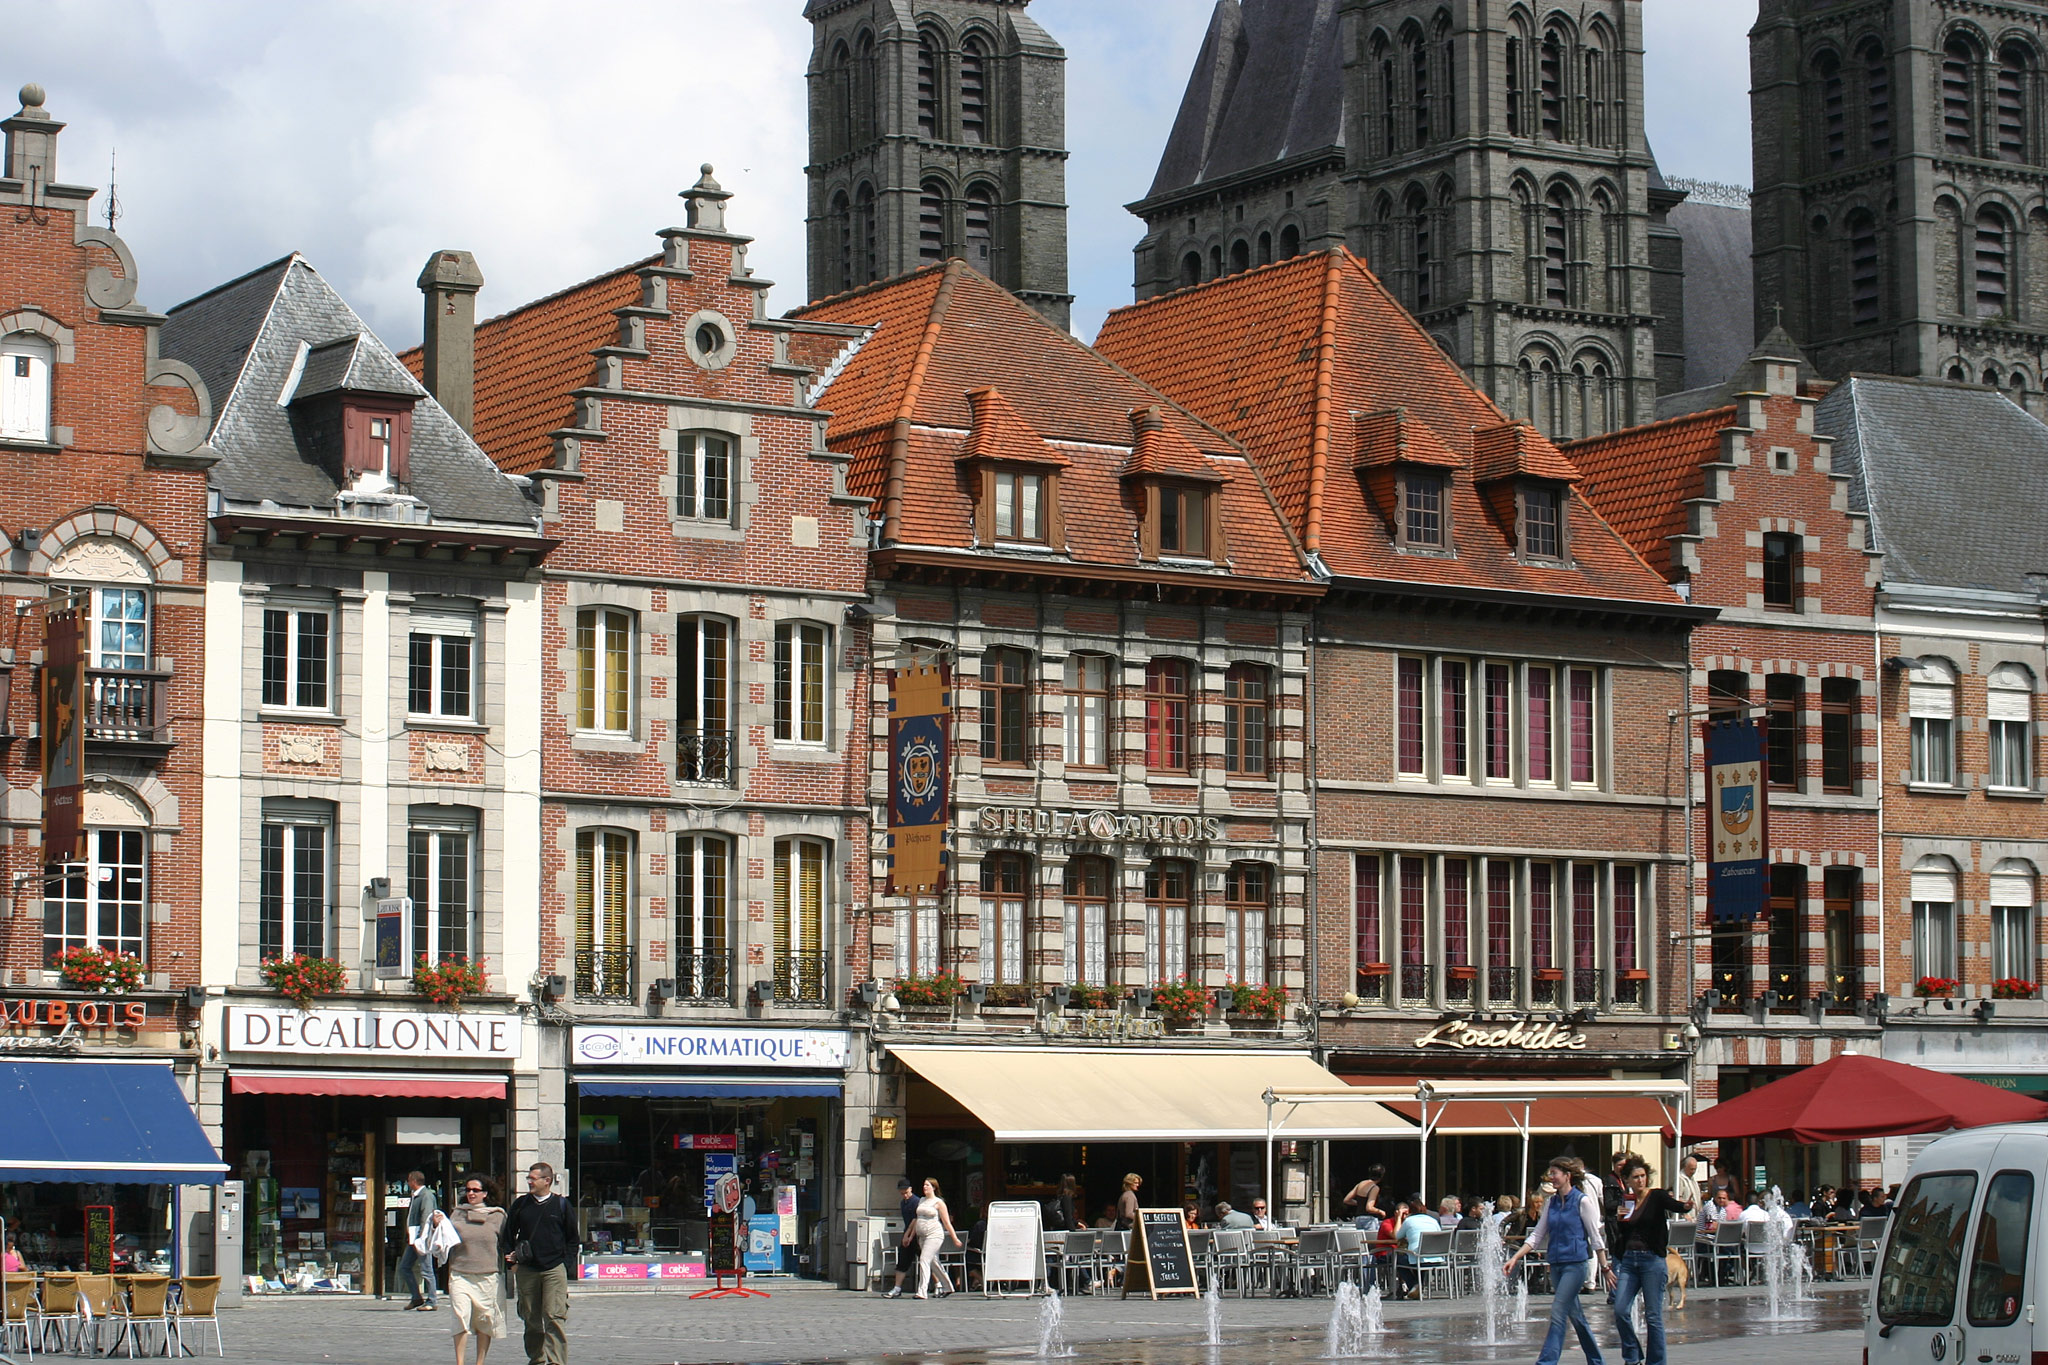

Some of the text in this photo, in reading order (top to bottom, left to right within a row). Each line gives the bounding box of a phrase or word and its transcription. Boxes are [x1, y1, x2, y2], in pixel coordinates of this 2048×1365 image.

[978, 805, 1219, 841] STELLA ARTOIS
[244, 1013, 508, 1052] DECALLONNE
[646, 1036, 803, 1061] INFORMATIQUE
[1413, 1019, 1587, 1050] L'orchidée
